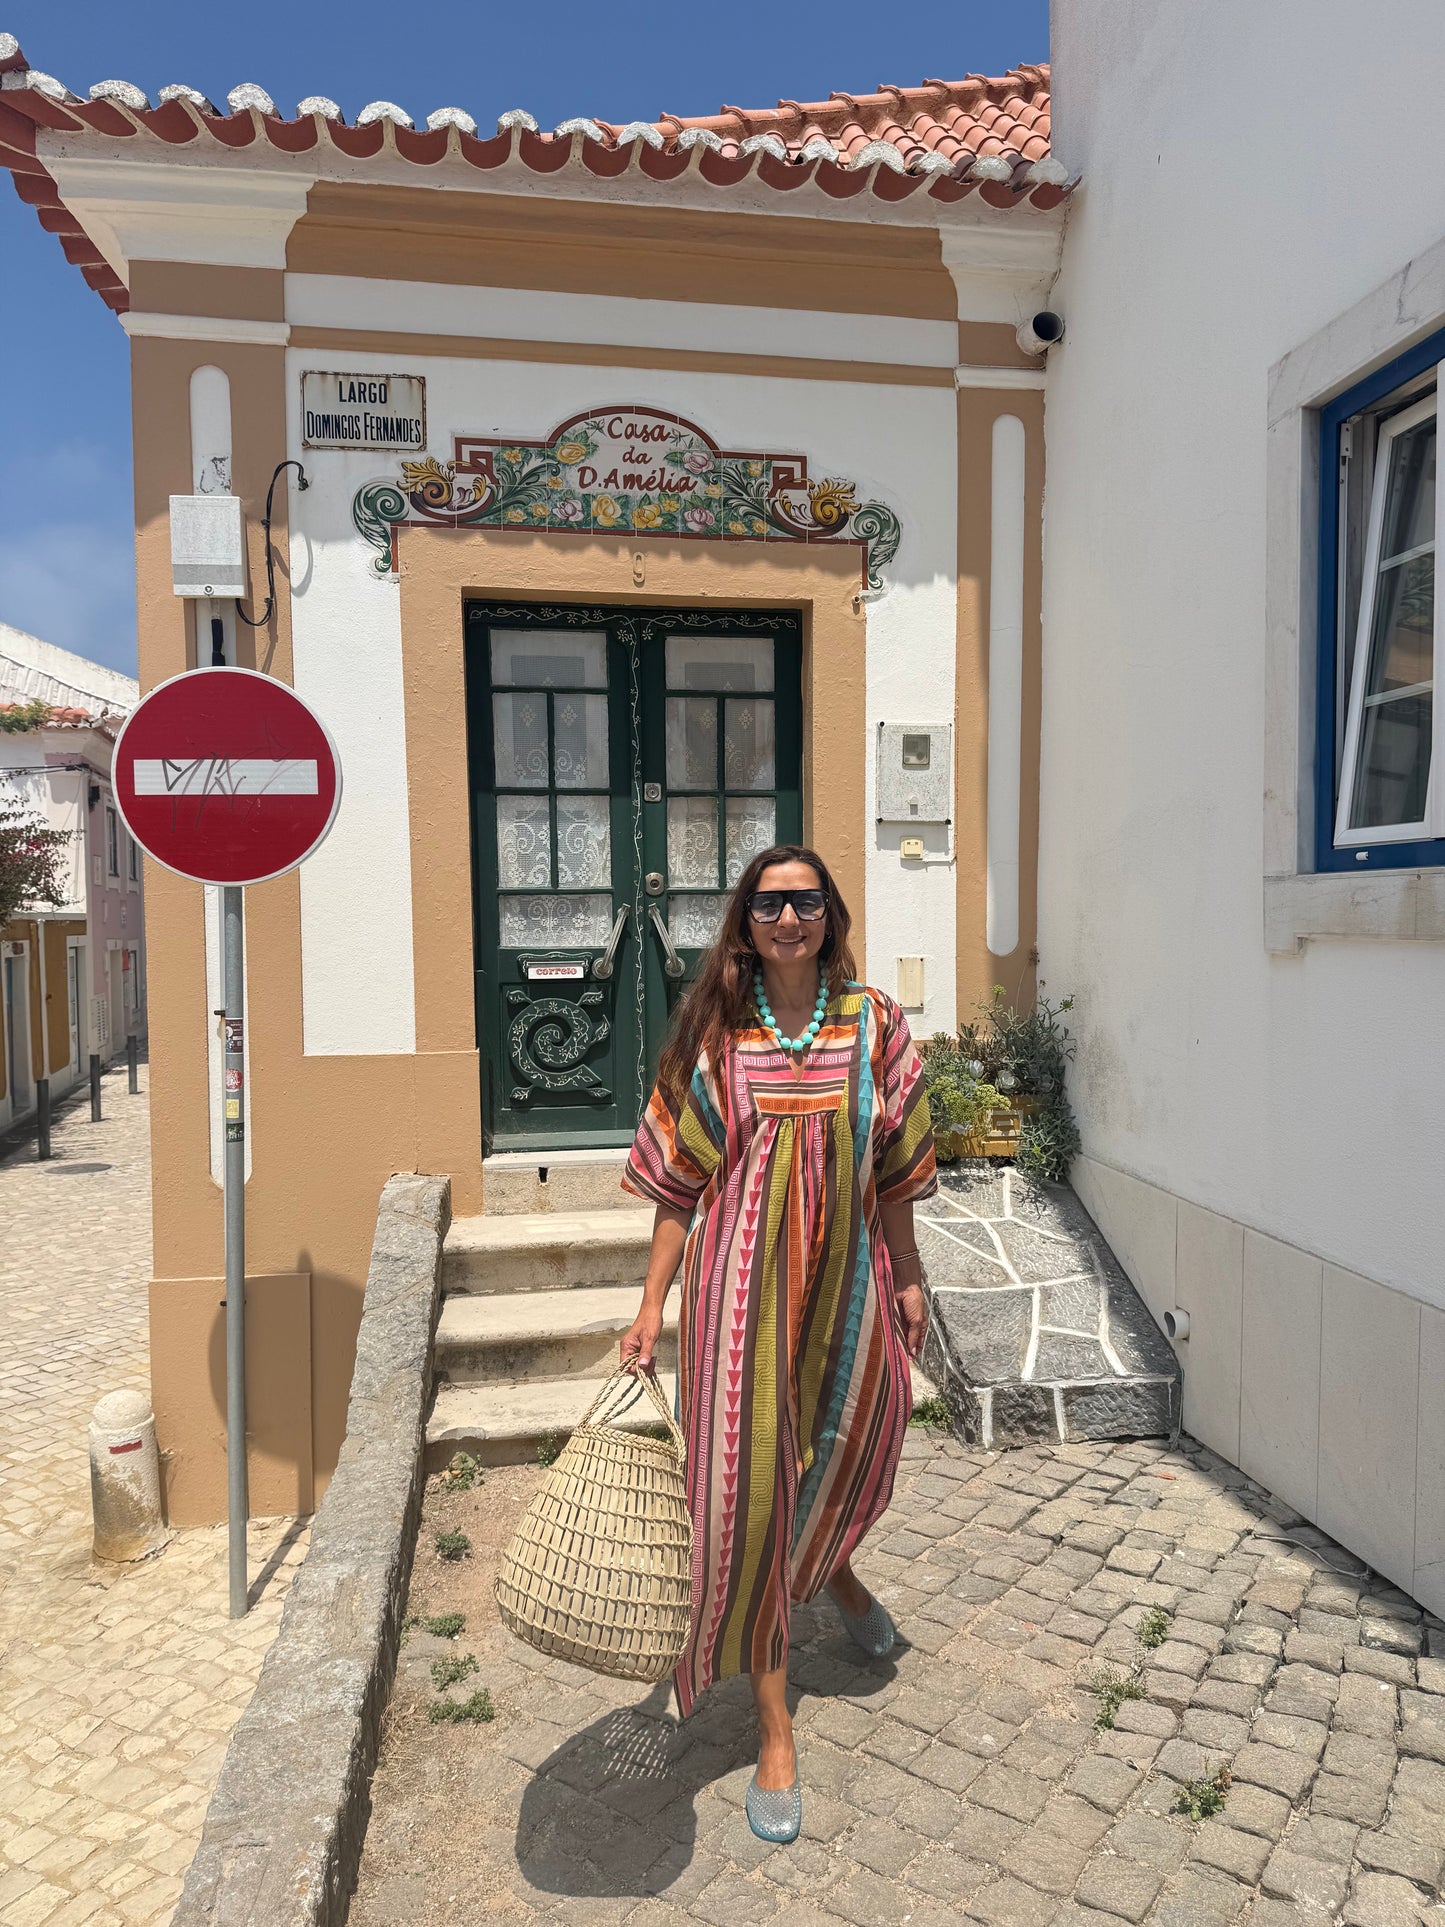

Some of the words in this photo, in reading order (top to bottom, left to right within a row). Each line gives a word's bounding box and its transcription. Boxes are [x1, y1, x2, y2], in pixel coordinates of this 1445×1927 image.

[338, 380, 388, 404] LARGO
[306, 411, 361, 440] DOMINGOS
[363, 412, 421, 443] FERNANDES
[607, 416, 671, 443] Casa
[622, 445, 653, 465] da
[633, 551, 645, 583] 9
